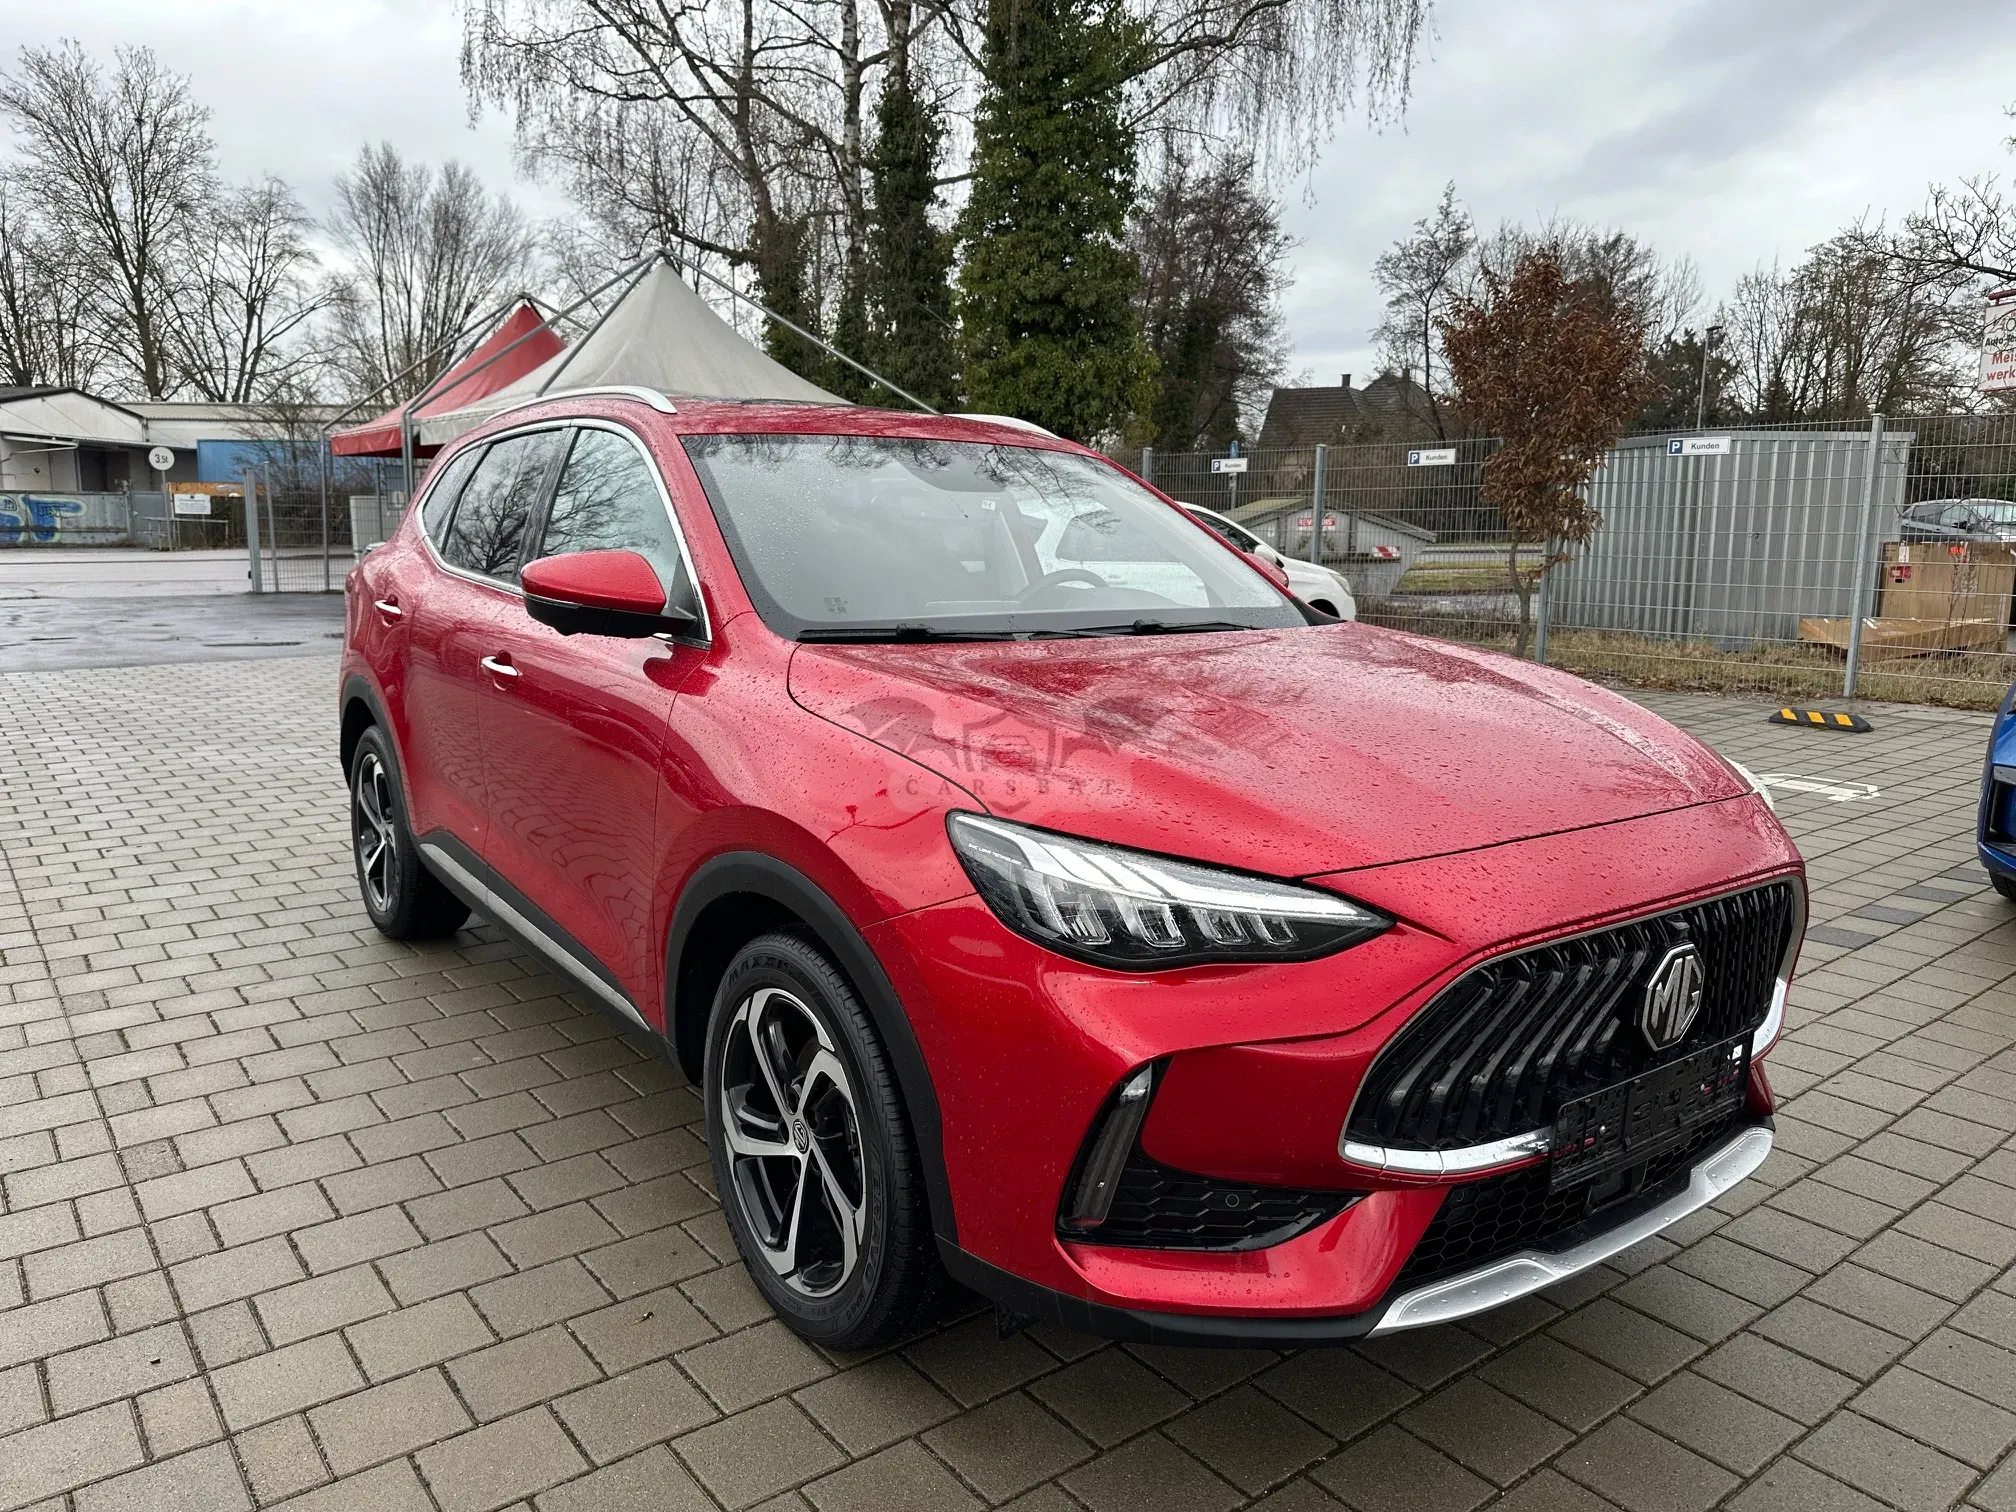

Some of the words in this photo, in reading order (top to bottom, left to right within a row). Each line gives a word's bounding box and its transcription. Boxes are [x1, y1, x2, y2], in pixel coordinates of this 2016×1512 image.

[1987, 365, 2016, 381] werk
[1672, 442, 1680, 452] P
[1411, 453, 1418, 463] P
[1214, 462, 1219, 470] P
[728, 955, 794, 987] MAXXIS
[1651, 955, 1702, 1042] MG
